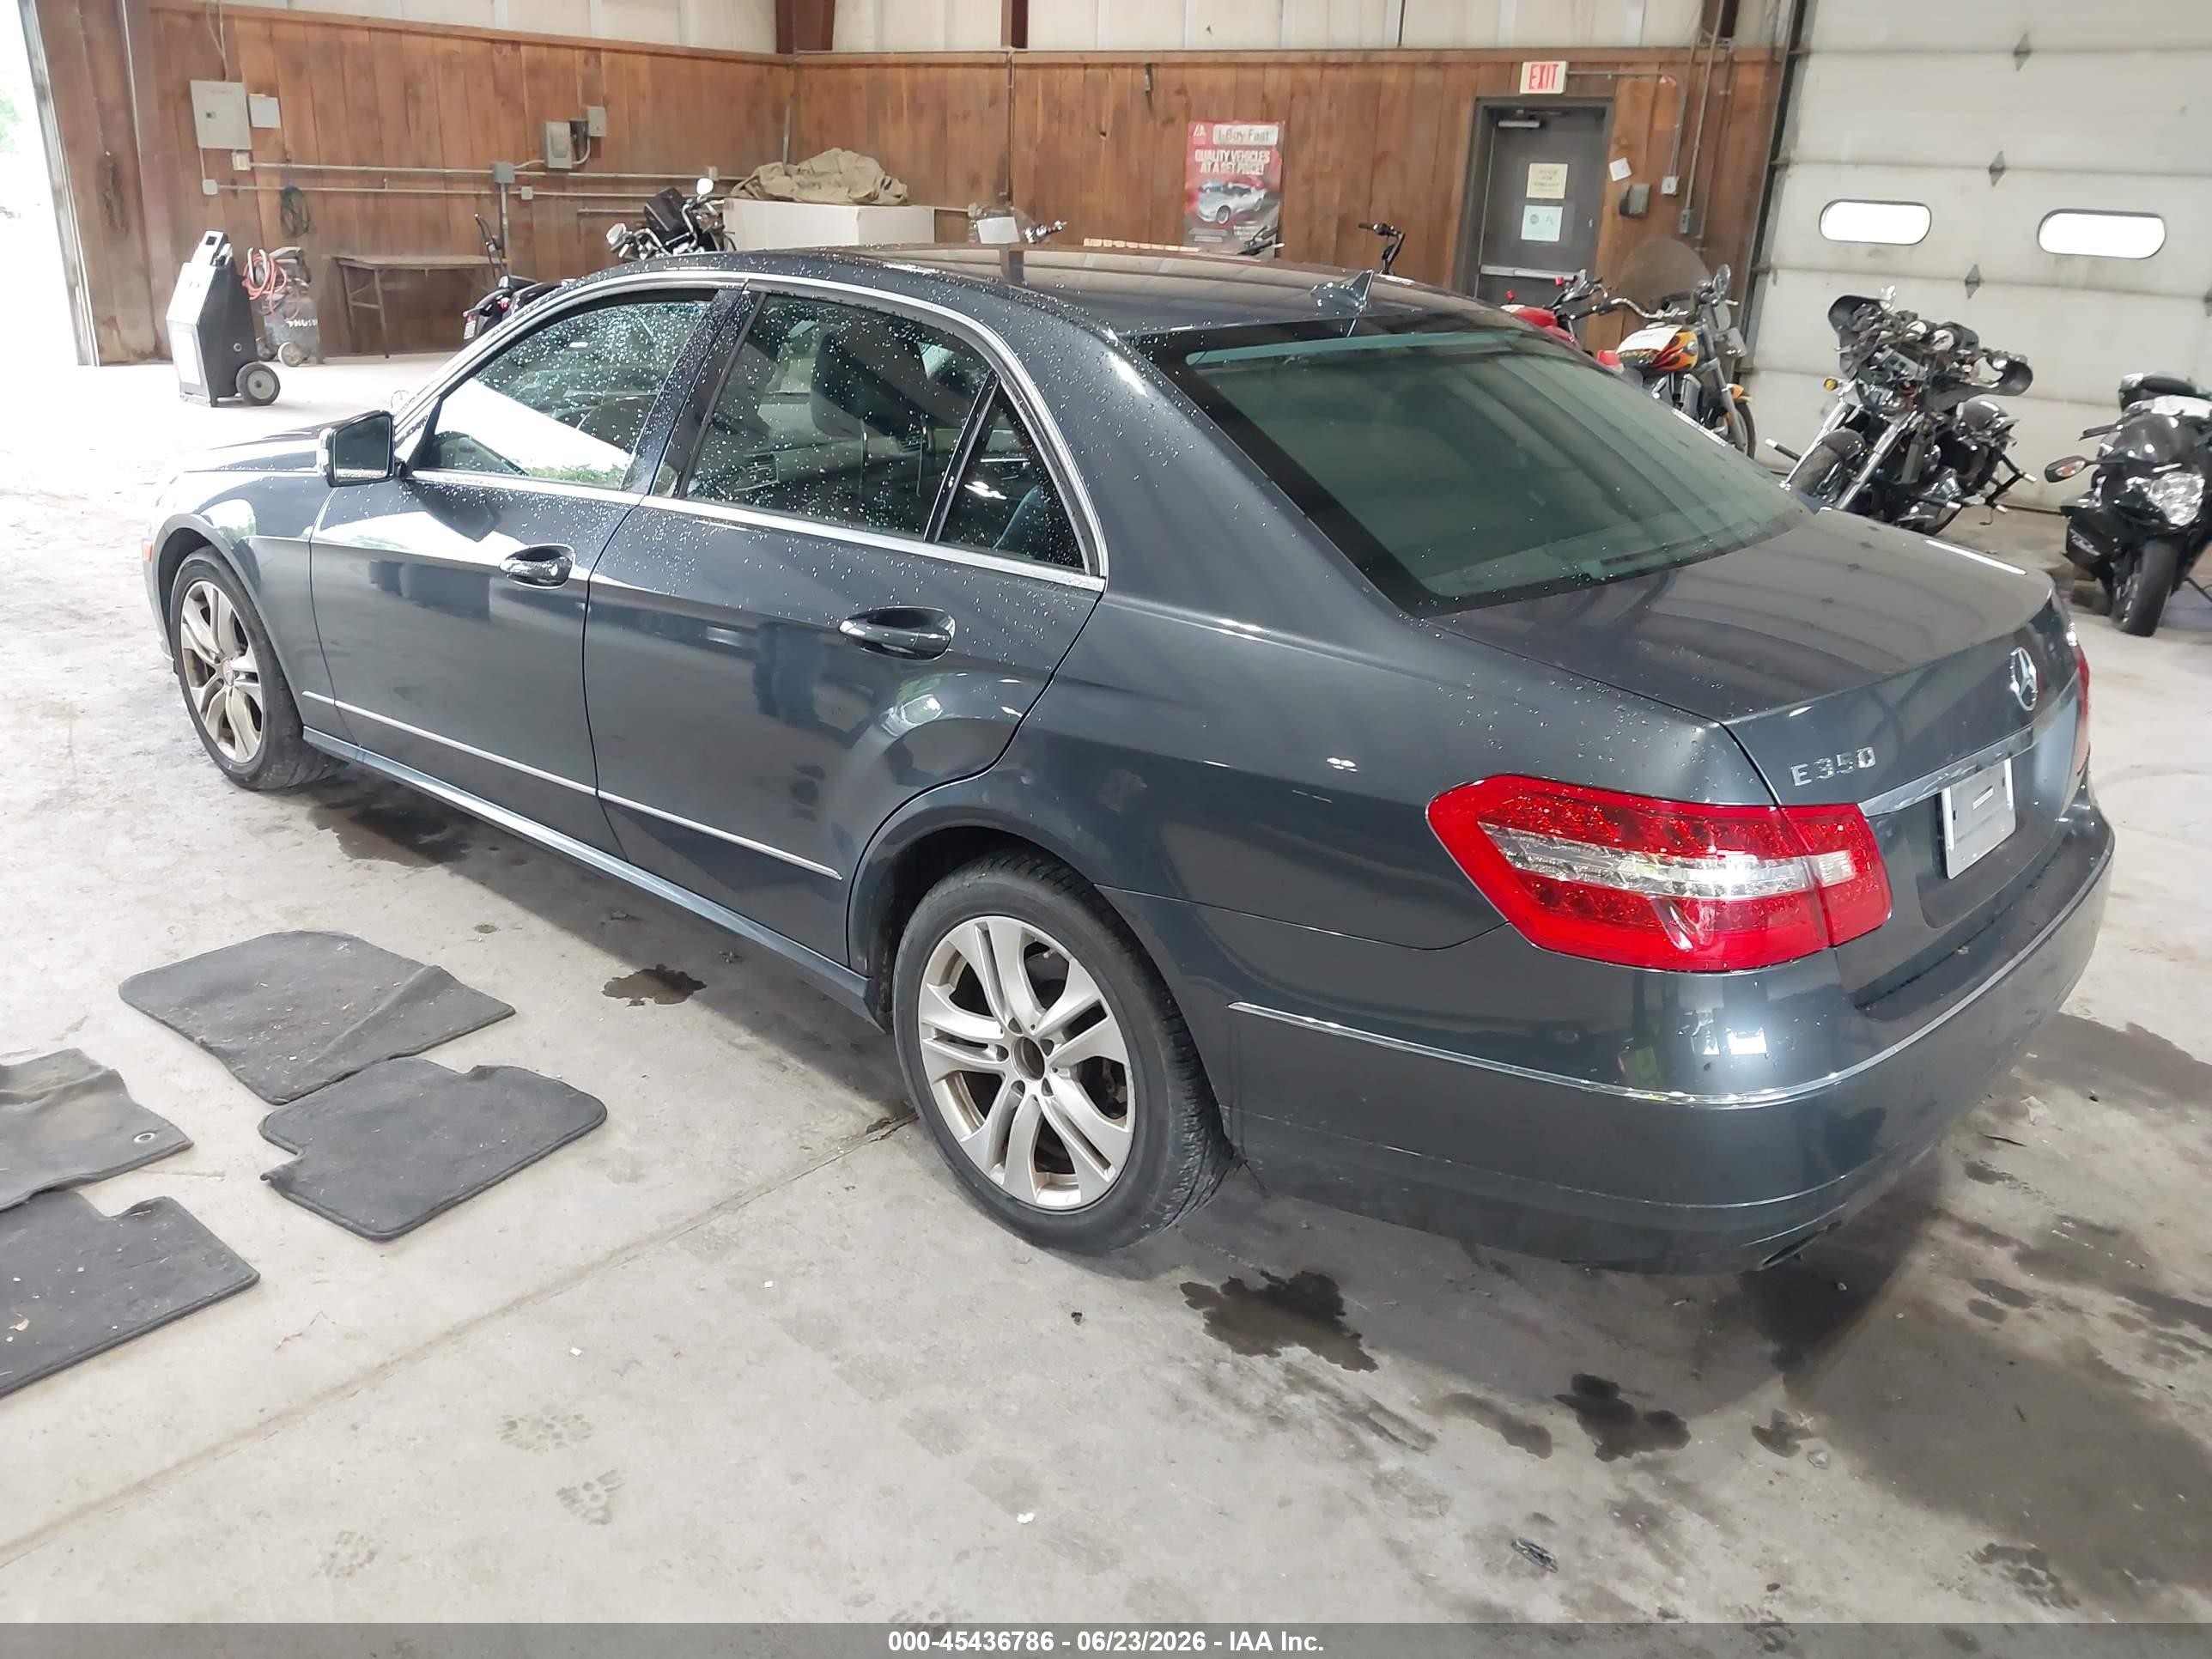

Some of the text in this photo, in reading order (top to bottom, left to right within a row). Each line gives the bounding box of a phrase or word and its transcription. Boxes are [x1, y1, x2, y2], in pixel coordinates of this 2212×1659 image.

[1528, 64, 1559, 90] EXIT
[1249, 129, 1270, 143] Fast
[1194, 149, 1271, 164] QUALITY VEHICLES
